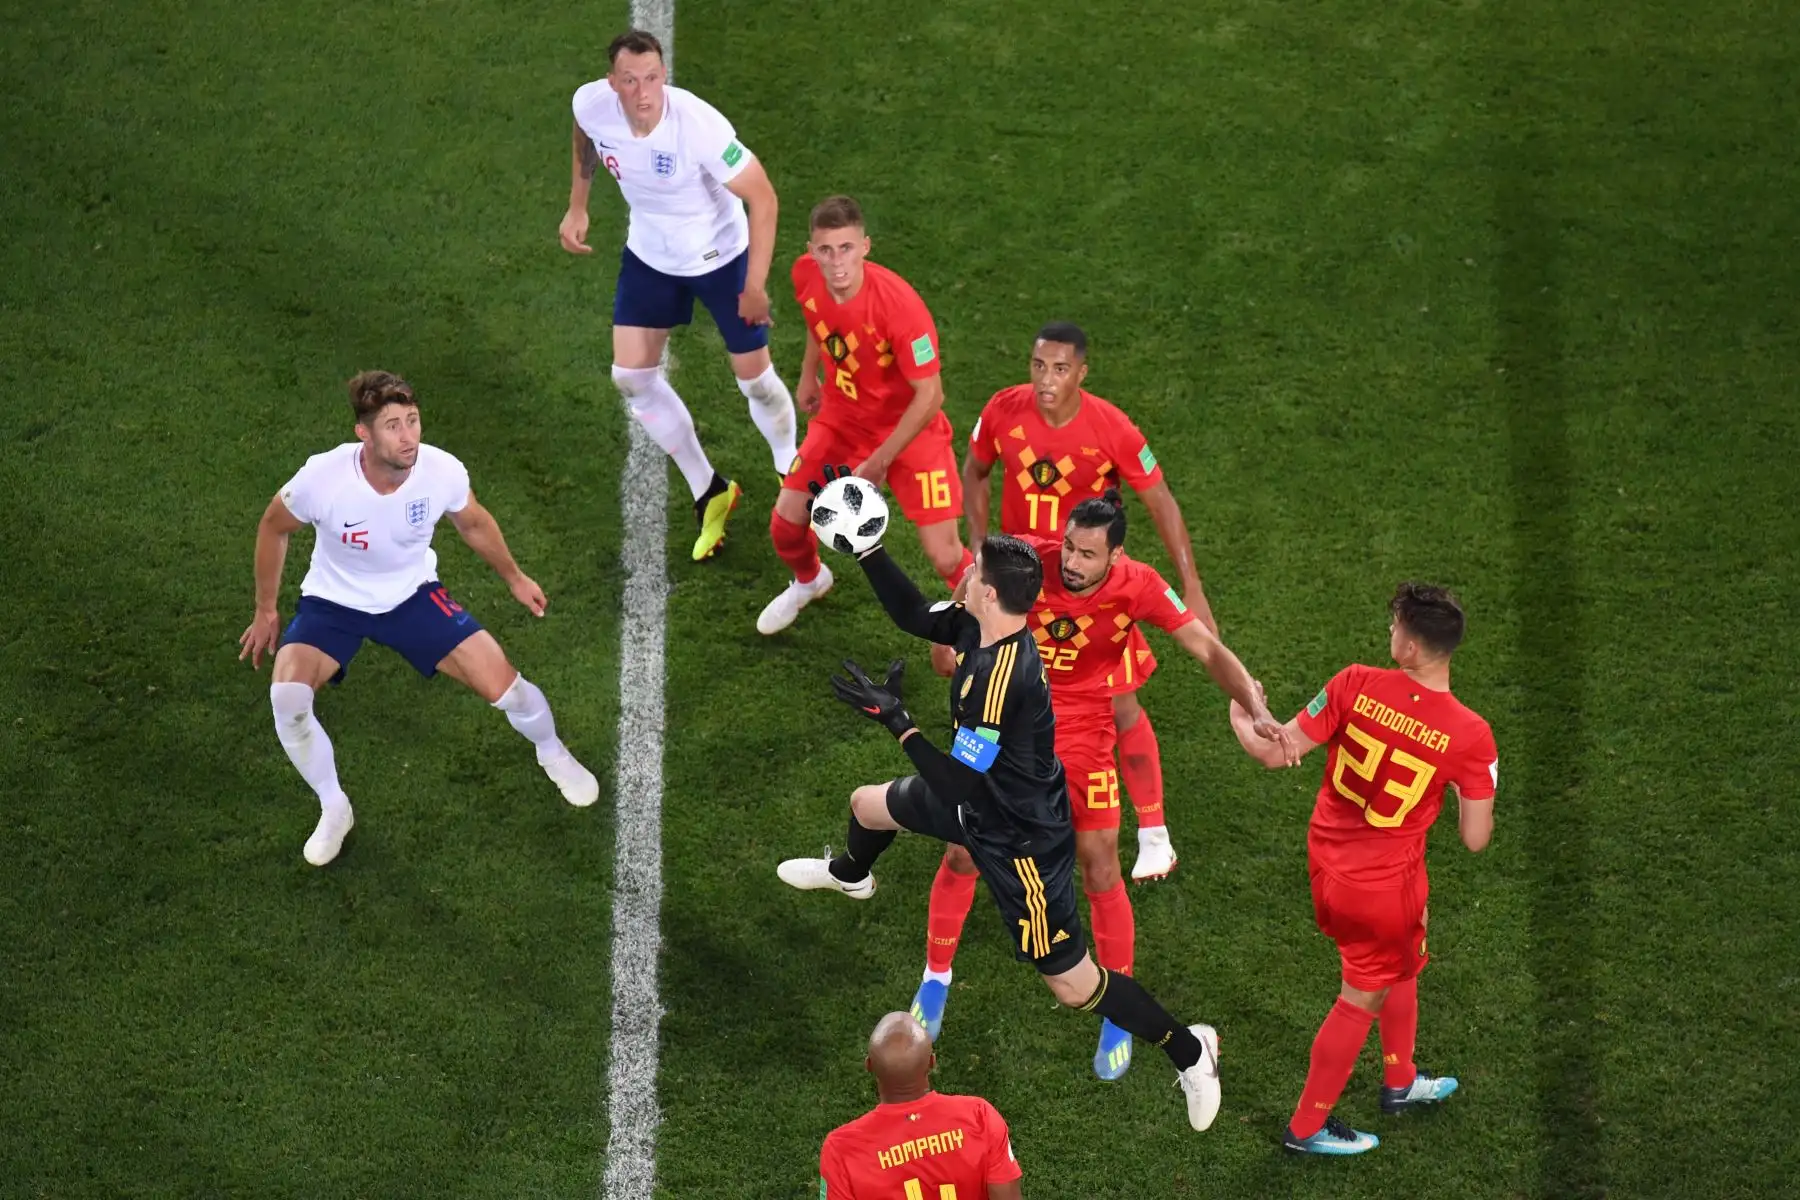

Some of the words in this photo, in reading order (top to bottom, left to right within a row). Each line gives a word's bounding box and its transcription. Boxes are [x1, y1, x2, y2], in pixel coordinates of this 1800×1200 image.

[915, 469, 951, 510] 16
[1025, 493, 1060, 532] 17
[341, 530, 369, 551] 15
[1036, 644, 1080, 671] 22
[1087, 767, 1120, 809] 22
[1332, 722, 1438, 828] 23
[877, 1128, 965, 1170] KOMPANY
